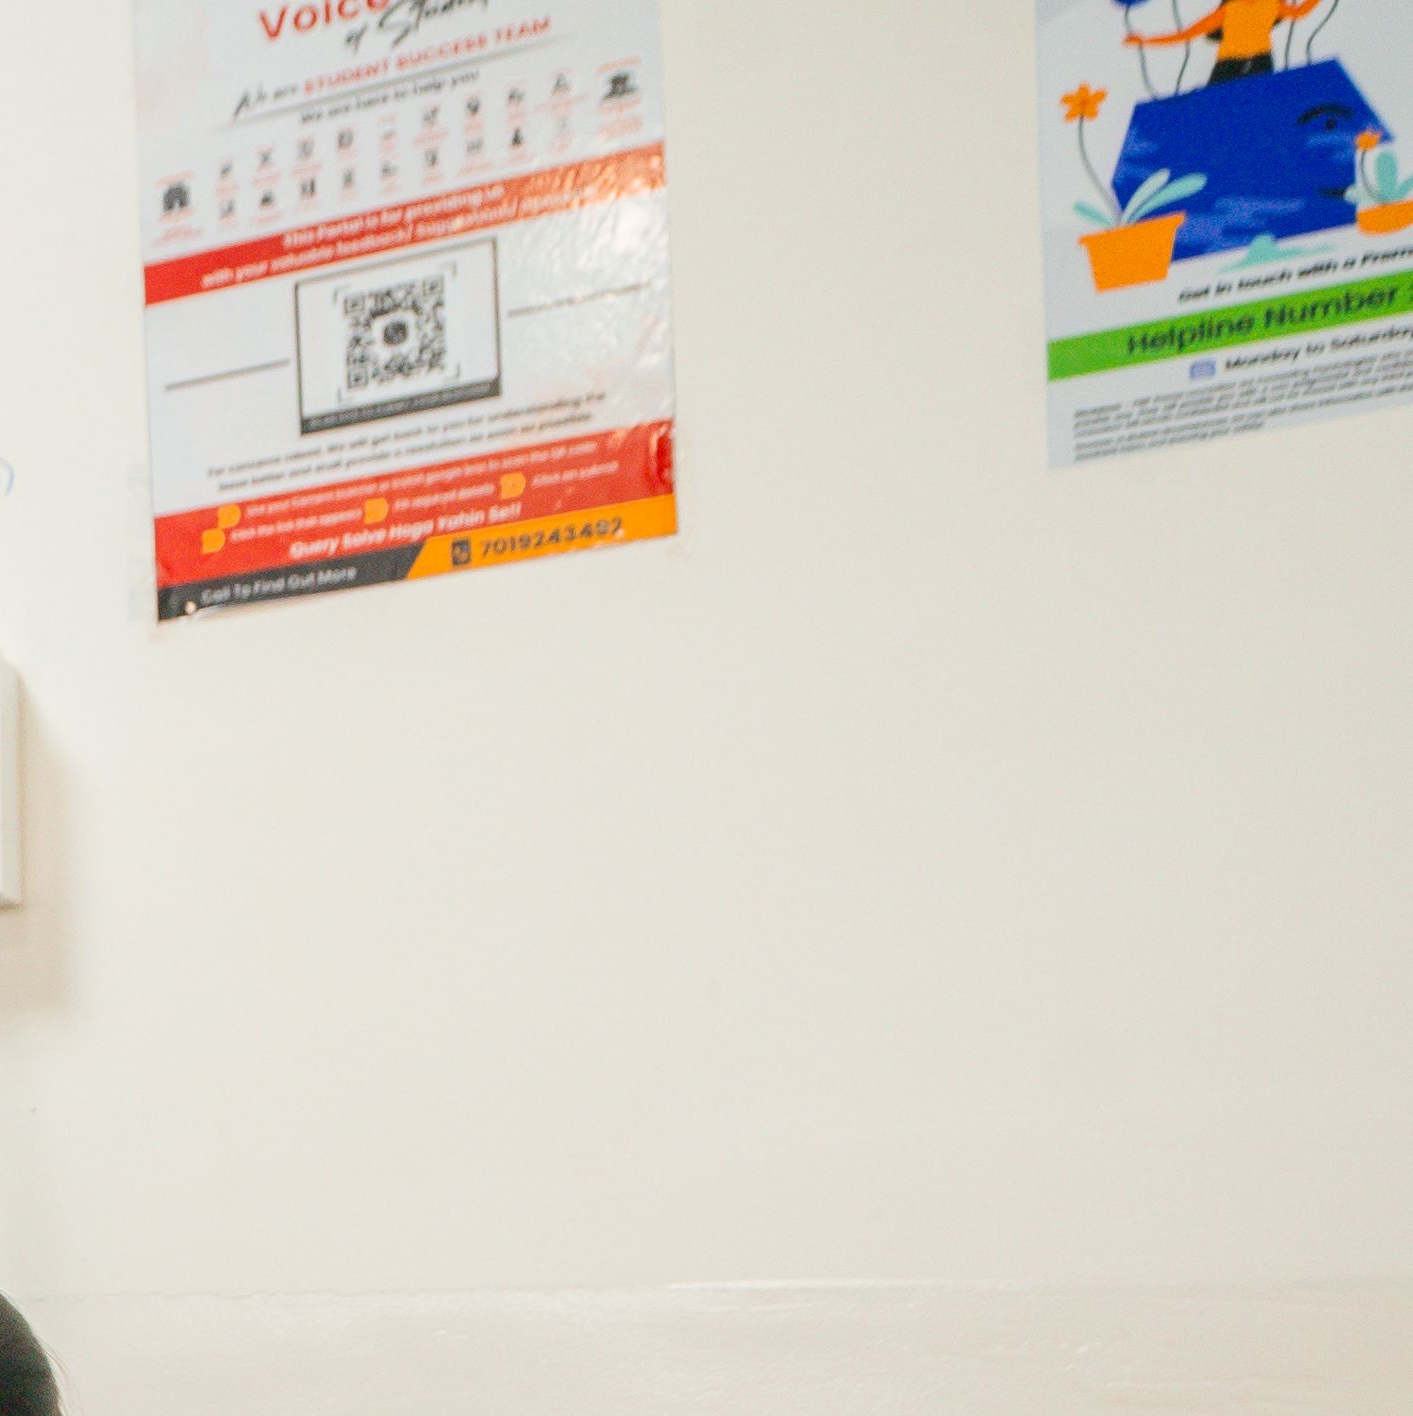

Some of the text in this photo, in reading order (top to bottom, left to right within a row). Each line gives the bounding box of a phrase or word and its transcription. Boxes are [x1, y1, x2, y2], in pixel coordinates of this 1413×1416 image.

[496, 15, 551, 44] TEAM
[1126, 286, 1399, 356] Helpline Number
